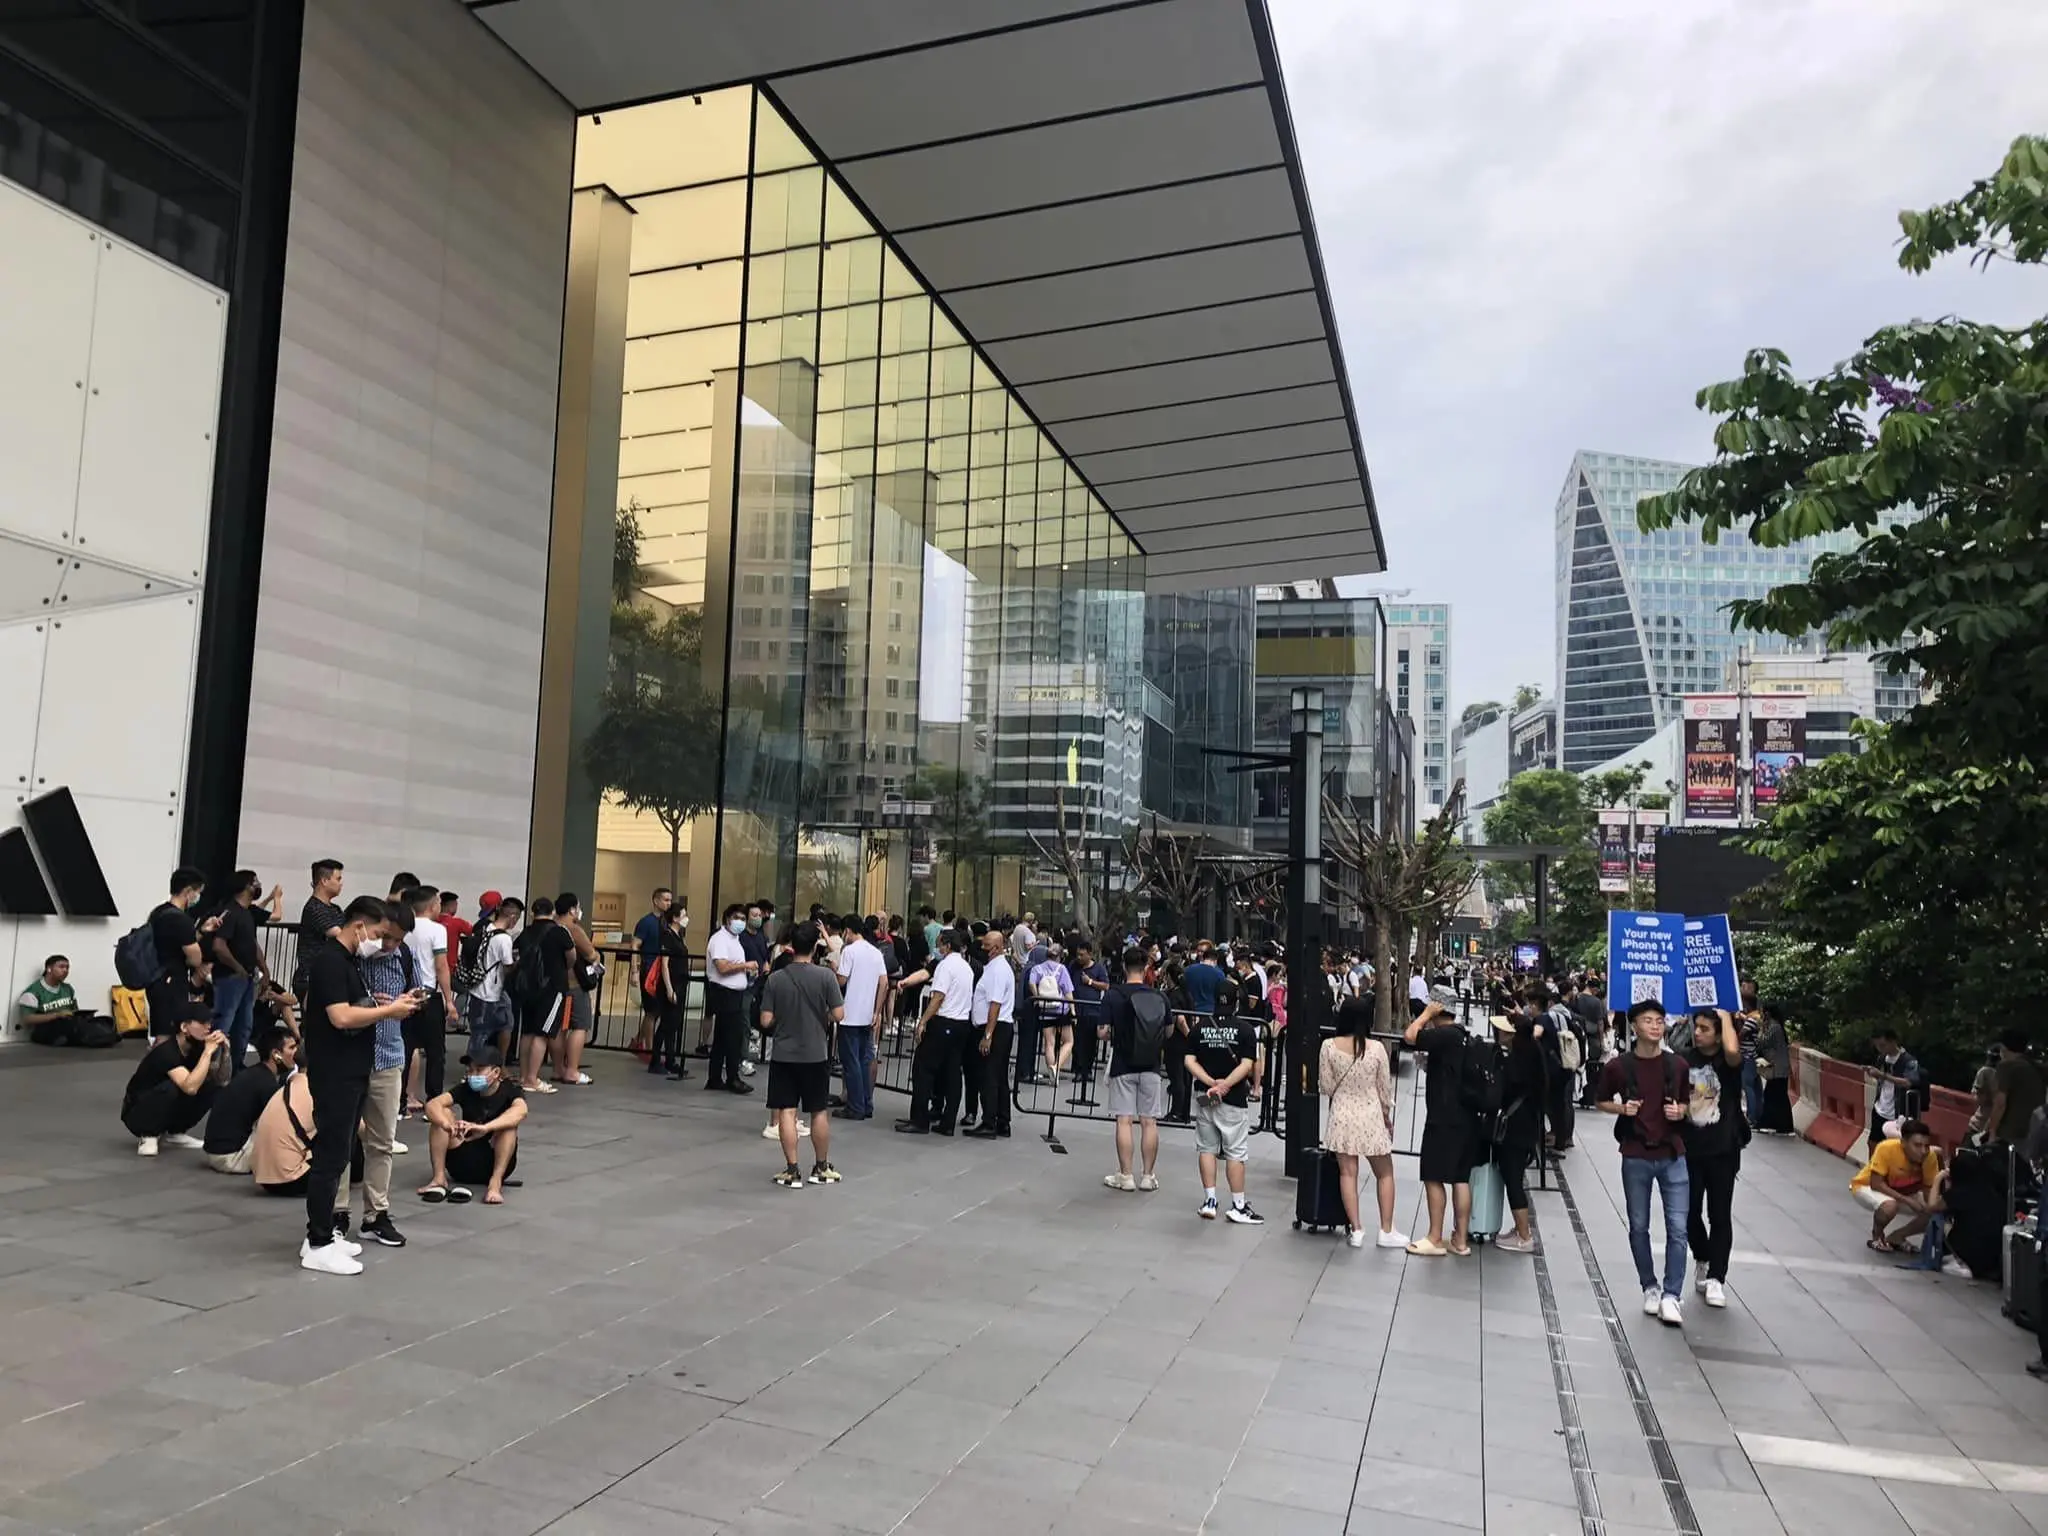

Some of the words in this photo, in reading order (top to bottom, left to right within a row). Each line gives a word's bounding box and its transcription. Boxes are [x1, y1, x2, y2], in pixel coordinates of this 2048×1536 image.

[1672, 827, 1693, 836] Parking
[1694, 827, 1717, 836] Location
[1623, 927, 1648, 938] Your
[1650, 931, 1671, 940] new
[1621, 938, 1658, 951] iPhone
[1660, 941, 1674, 952] 14
[1683, 933, 1711, 947] REE
[1685, 945, 1724, 956] MONTHS
[1627, 951, 1659, 961] needs
[1661, 953, 1668, 962] a
[1620, 961, 1642, 971] new
[1644, 962, 1673, 973] telco.
[1687, 965, 1711, 975] DATA
[1218, 1027, 1239, 1035] YORK
